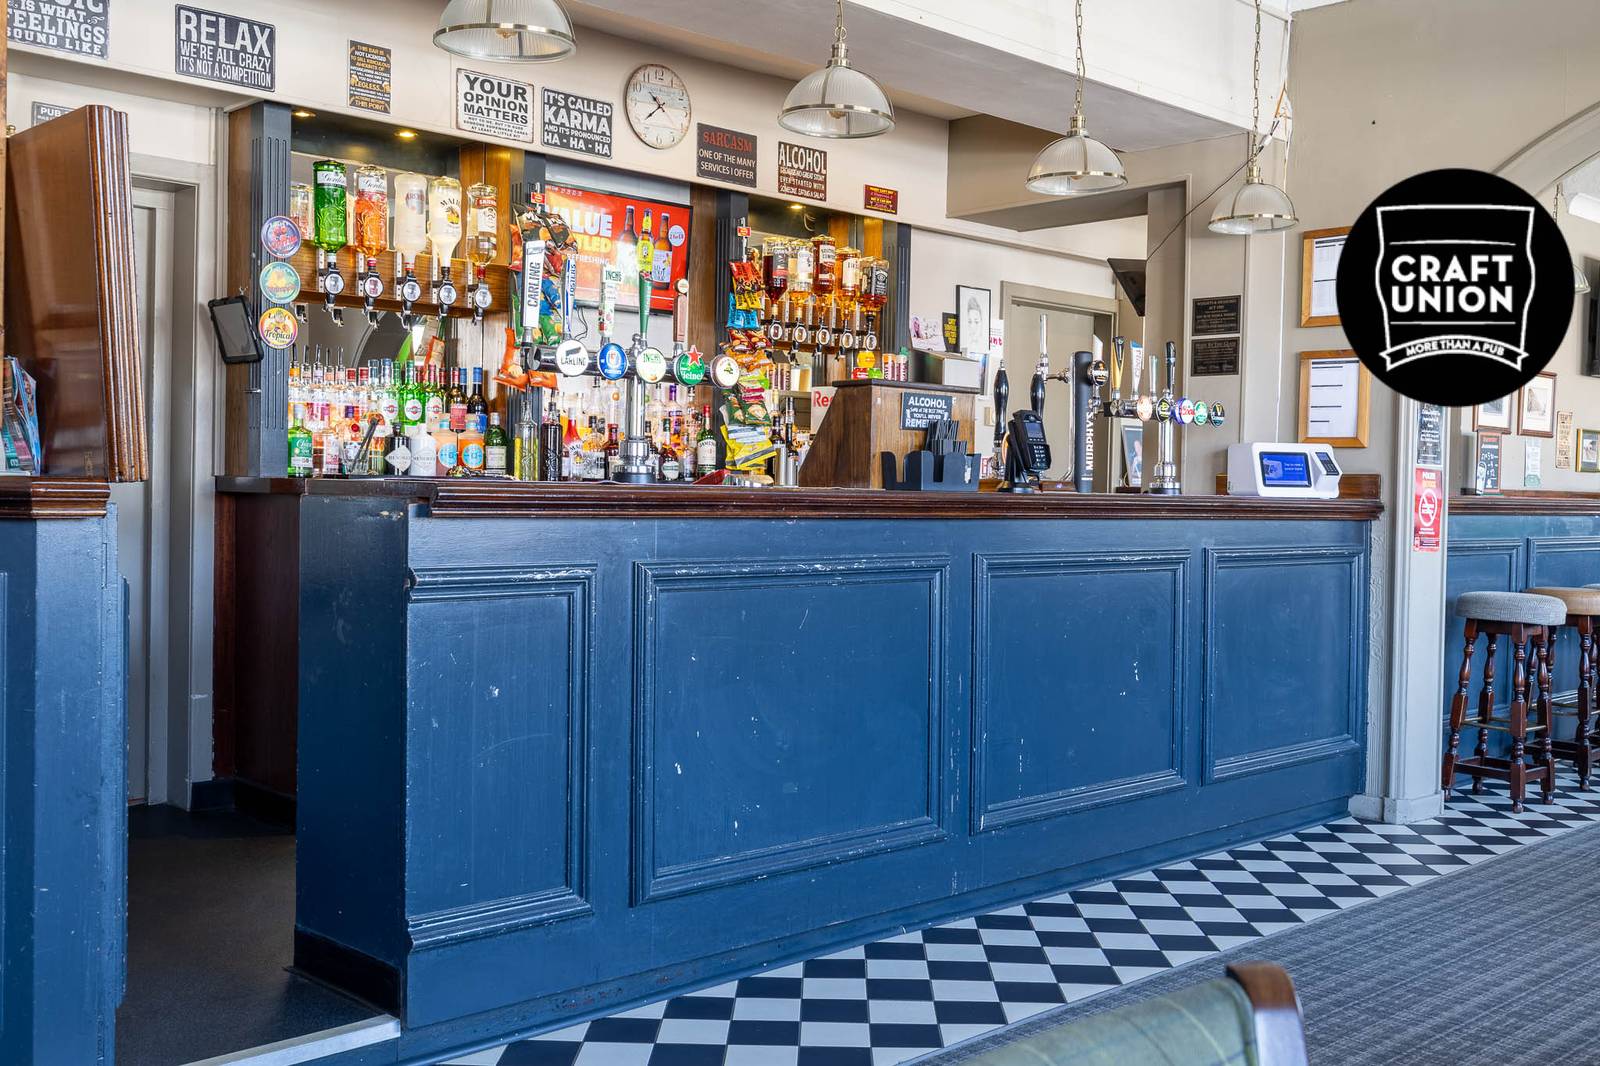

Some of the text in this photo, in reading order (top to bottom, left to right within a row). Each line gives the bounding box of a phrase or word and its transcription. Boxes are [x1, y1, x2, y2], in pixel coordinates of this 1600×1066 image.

[39, 2, 86, 22] WHAT
[180, 9, 271, 58] RELAX
[65, 38, 102, 55] LIKE
[180, 40, 271, 73] WE'RE ALL CRAZY
[180, 55, 271, 88] IT'S NOT A COMPETITION
[464, 74, 528, 102] YOUR
[40, 106, 61, 117] PUB
[463, 91, 528, 114] OPINION
[464, 103, 528, 125] MATTERS
[544, 90, 612, 117] IT'S CALLED
[544, 103, 611, 137] KARMA
[544, 123, 611, 144] AND IT'S PRONOUNCED
[544, 131, 561, 146] HA
[569, 136, 586, 151] HA
[594, 141, 611, 156] HA
[703, 131, 753, 152] SARCASM
[698, 148, 756, 168] ONE OF THE MANY
[778, 143, 827, 175] ALCOHOL
[700, 160, 730, 175] SERVICES
[733, 168, 754, 180] OFFER
[527, 261, 541, 308] CARLING
[908, 396, 947, 409] ALCOHOL
